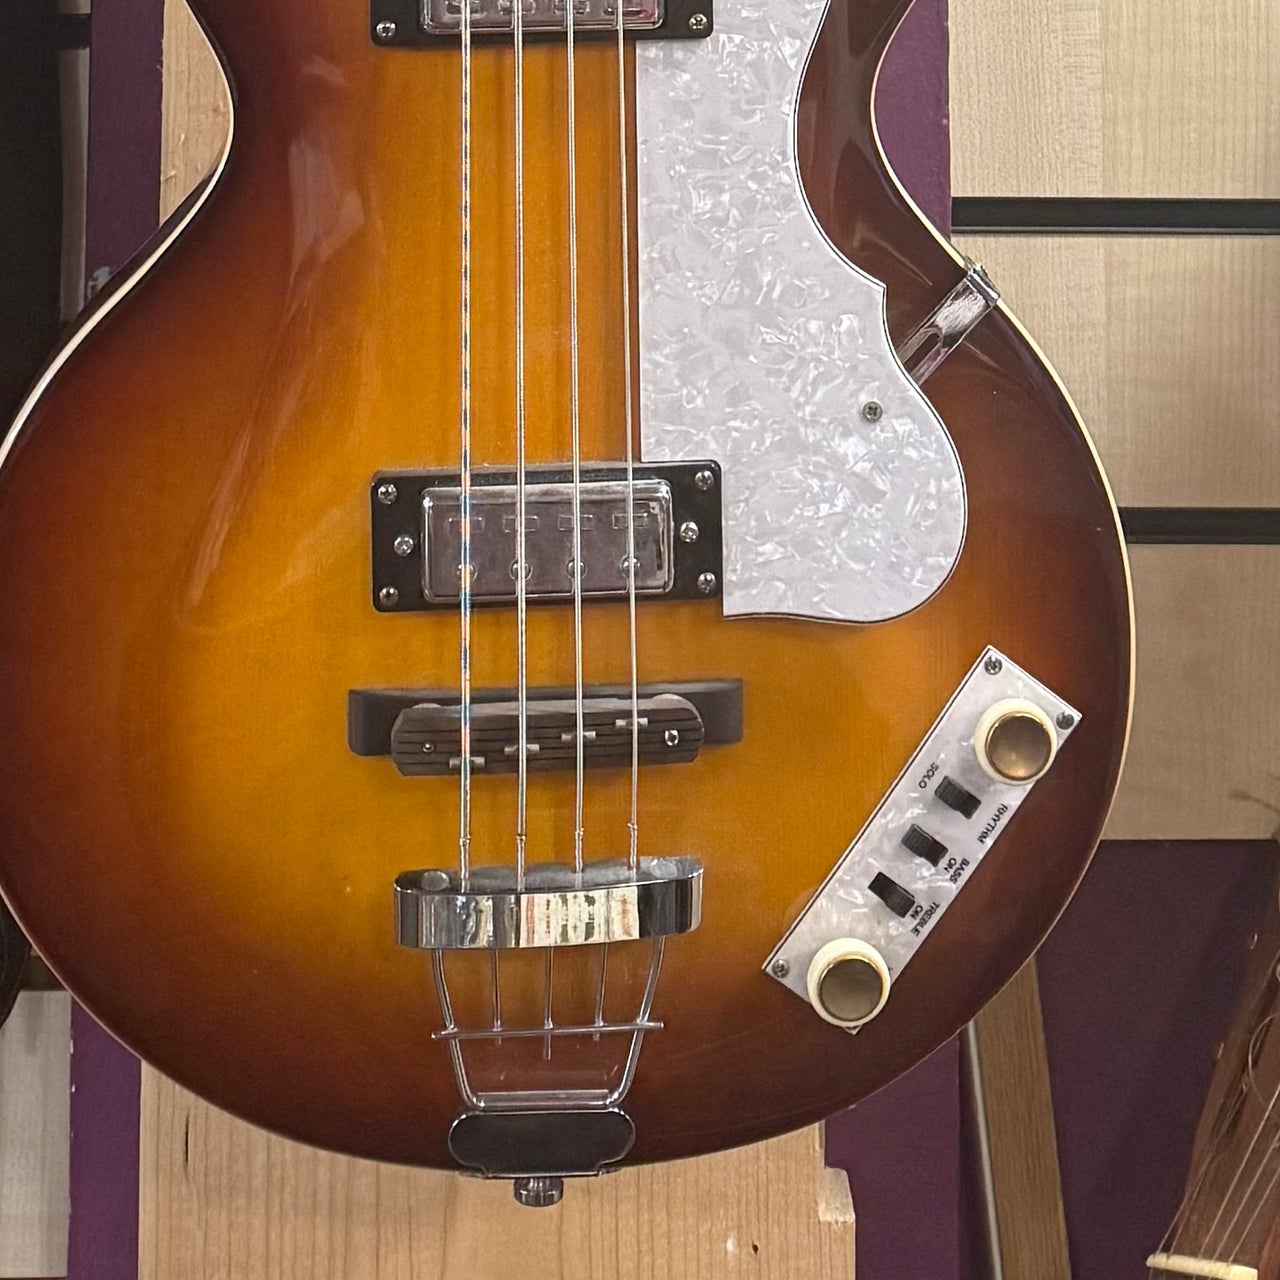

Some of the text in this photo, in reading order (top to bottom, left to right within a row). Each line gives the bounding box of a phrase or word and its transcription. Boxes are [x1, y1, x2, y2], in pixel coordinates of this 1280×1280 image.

[918, 762, 940, 789] SOLO
[977, 803, 1009, 844] RHYTHM
[943, 857, 957, 873] ON
[949, 858, 970, 884] BASS
[911, 904, 924, 920] ON
[911, 901, 941, 937] TREBLE
